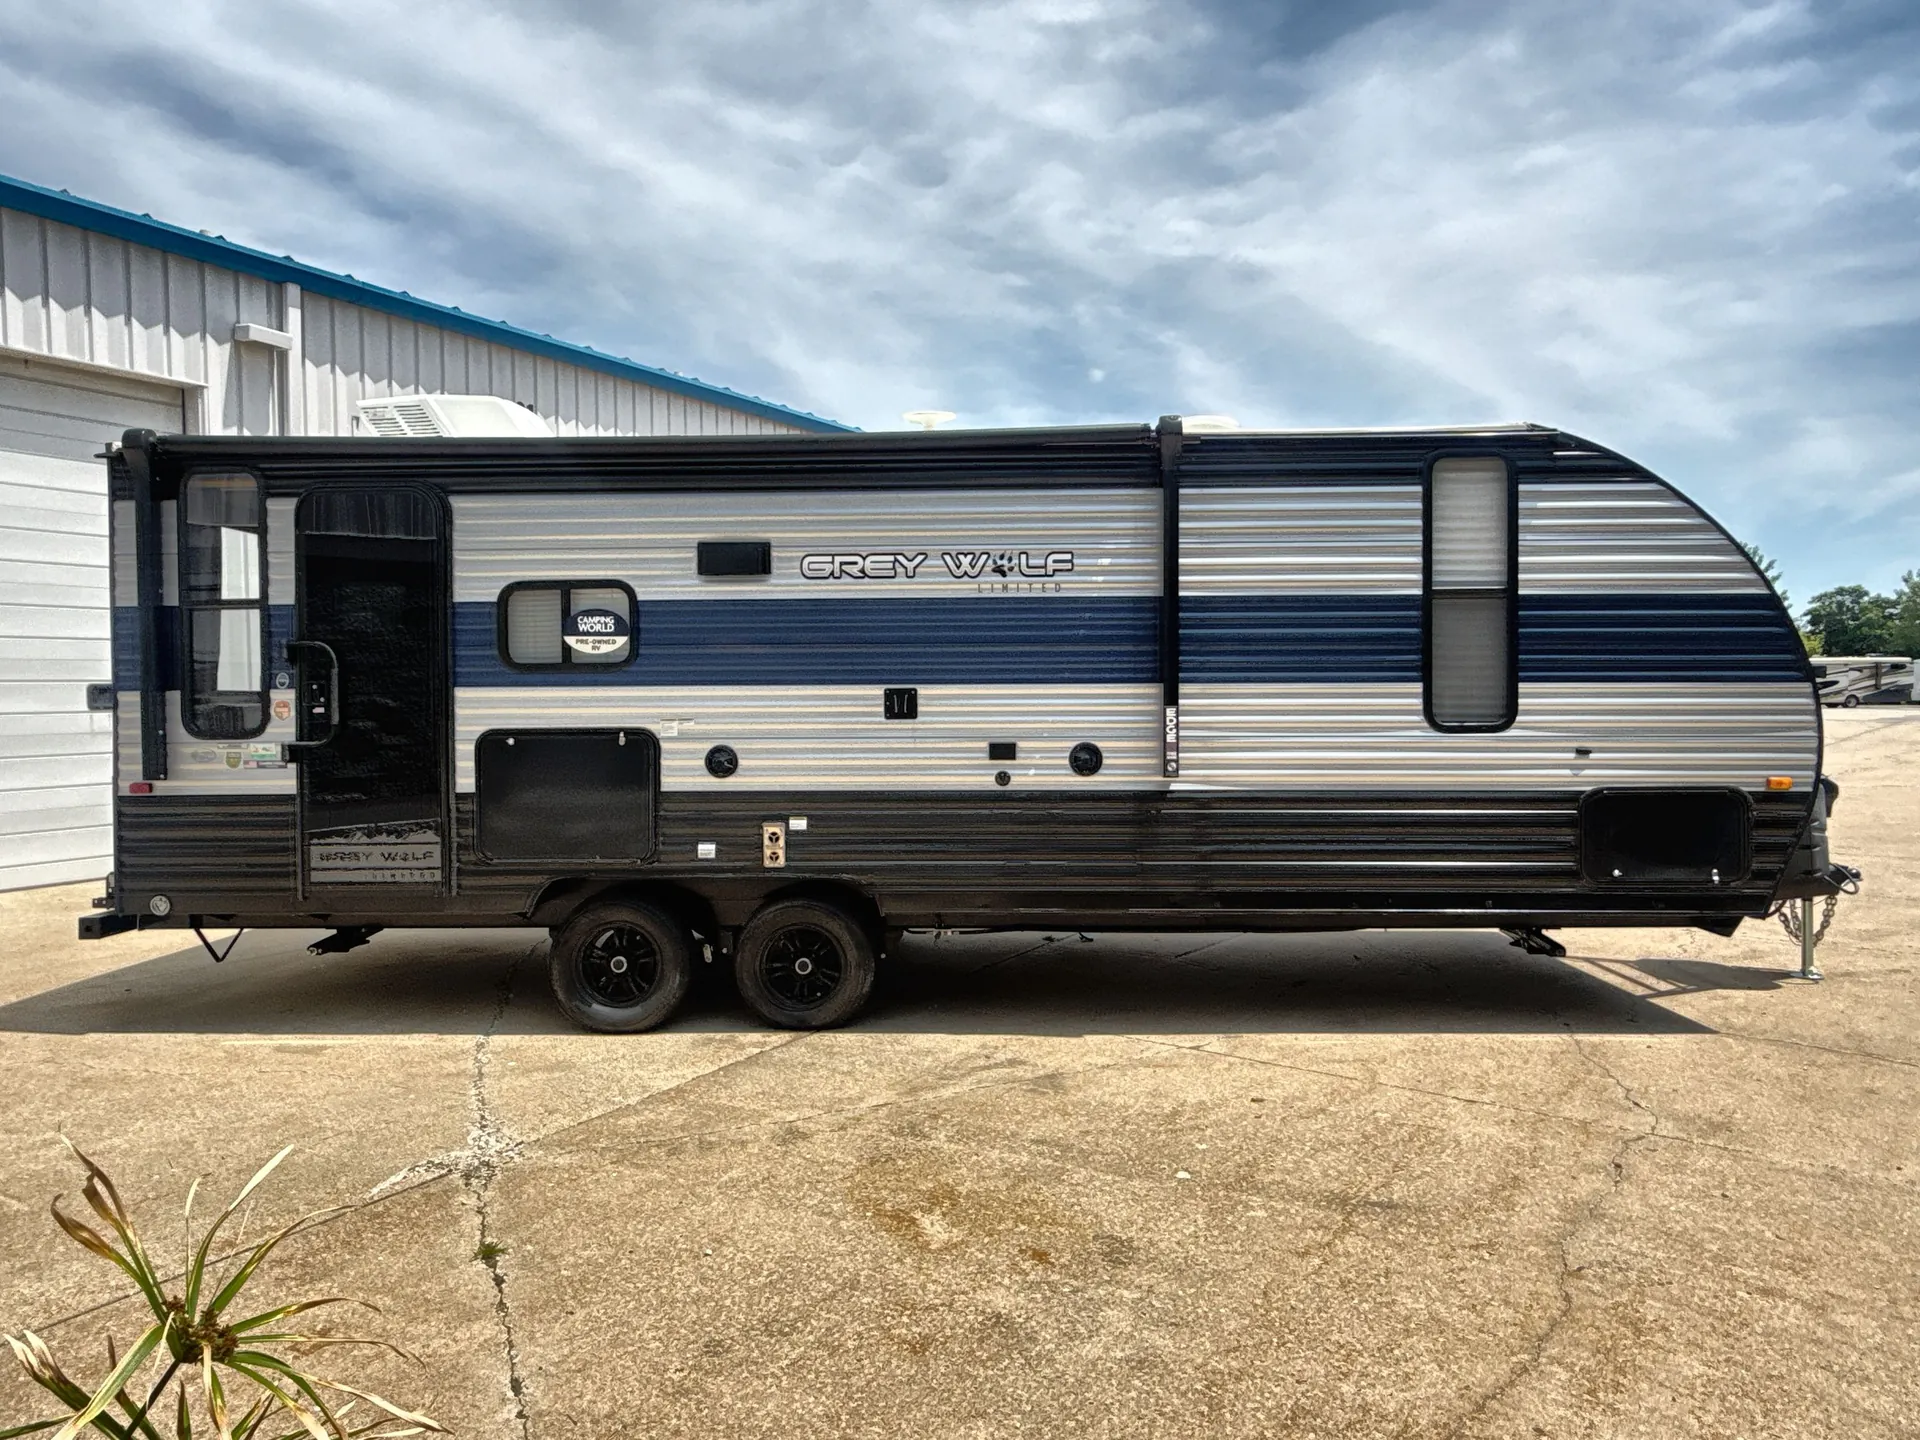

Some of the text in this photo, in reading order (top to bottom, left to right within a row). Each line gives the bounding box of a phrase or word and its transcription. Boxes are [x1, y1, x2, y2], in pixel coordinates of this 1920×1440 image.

[800, 552, 928, 580] GREY
[977, 583, 1061, 593] LIMITED
[577, 616, 614, 624] CAMPING
[577, 623, 614, 632] WORLD
[1165, 707, 1177, 743] EDGE
